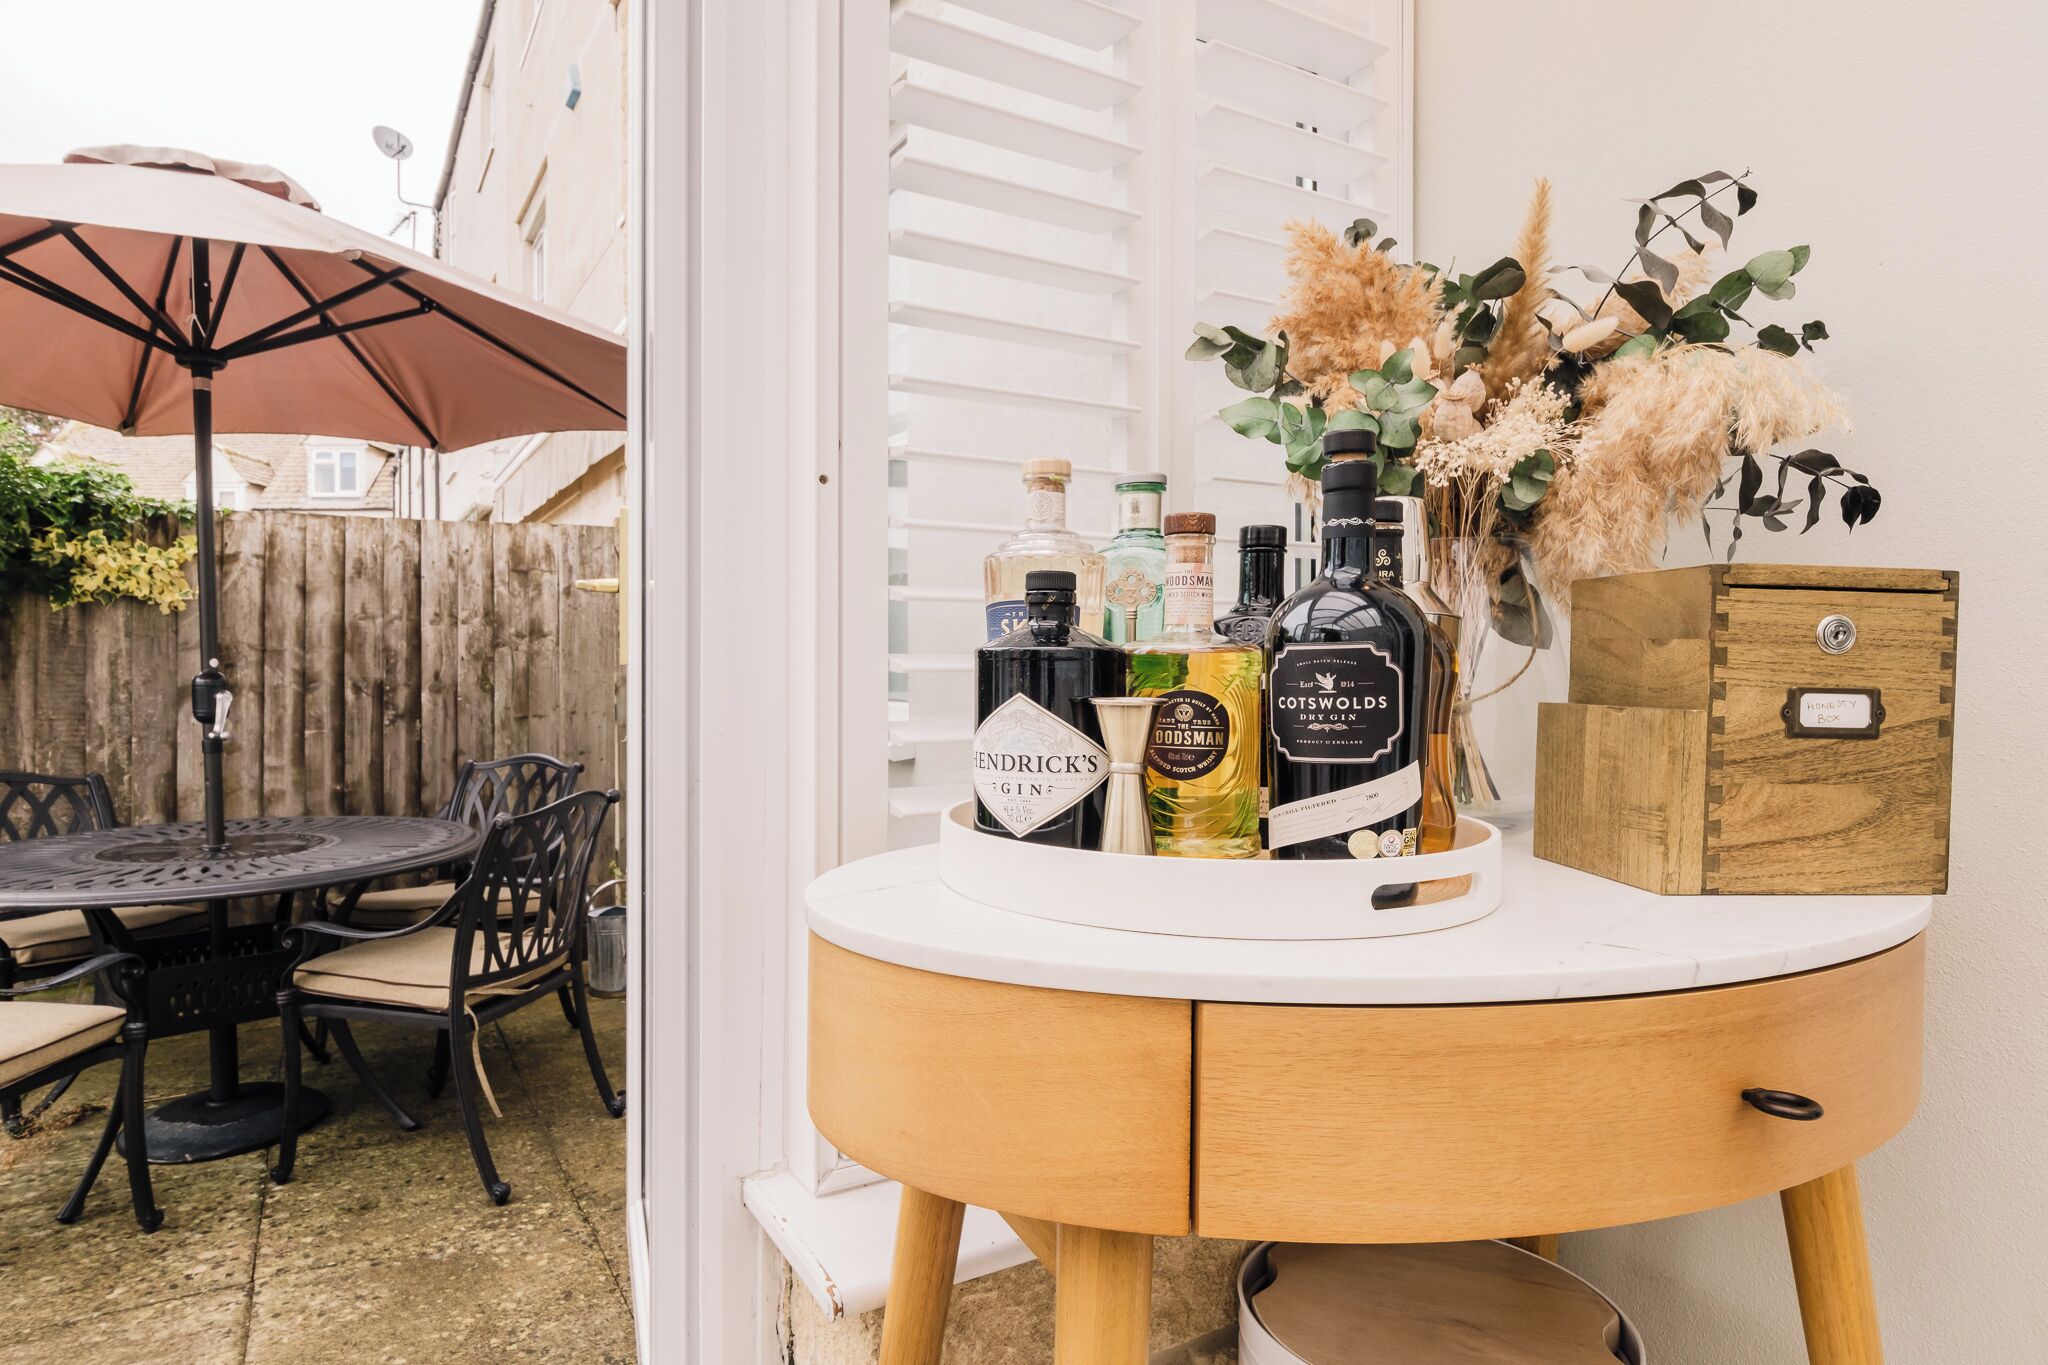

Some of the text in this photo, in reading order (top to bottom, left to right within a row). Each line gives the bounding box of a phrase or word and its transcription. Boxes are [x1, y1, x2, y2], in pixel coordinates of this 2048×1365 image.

[1278, 696, 1388, 710] COTSWOLDS
[1807, 700, 1857, 711] HONESTY
[1817, 713, 1842, 724] BOX
[1155, 730, 1224, 746] OODSMAN
[974, 751, 1098, 774] HENDRICK'S
[1150, 749, 1171, 770] BLENDED
[1197, 750, 1218, 770] WHISKY
[1001, 782, 1042, 796] GIN
[1300, 799, 1337, 812] FILTERED
[1404, 836, 1416, 844] GIN
